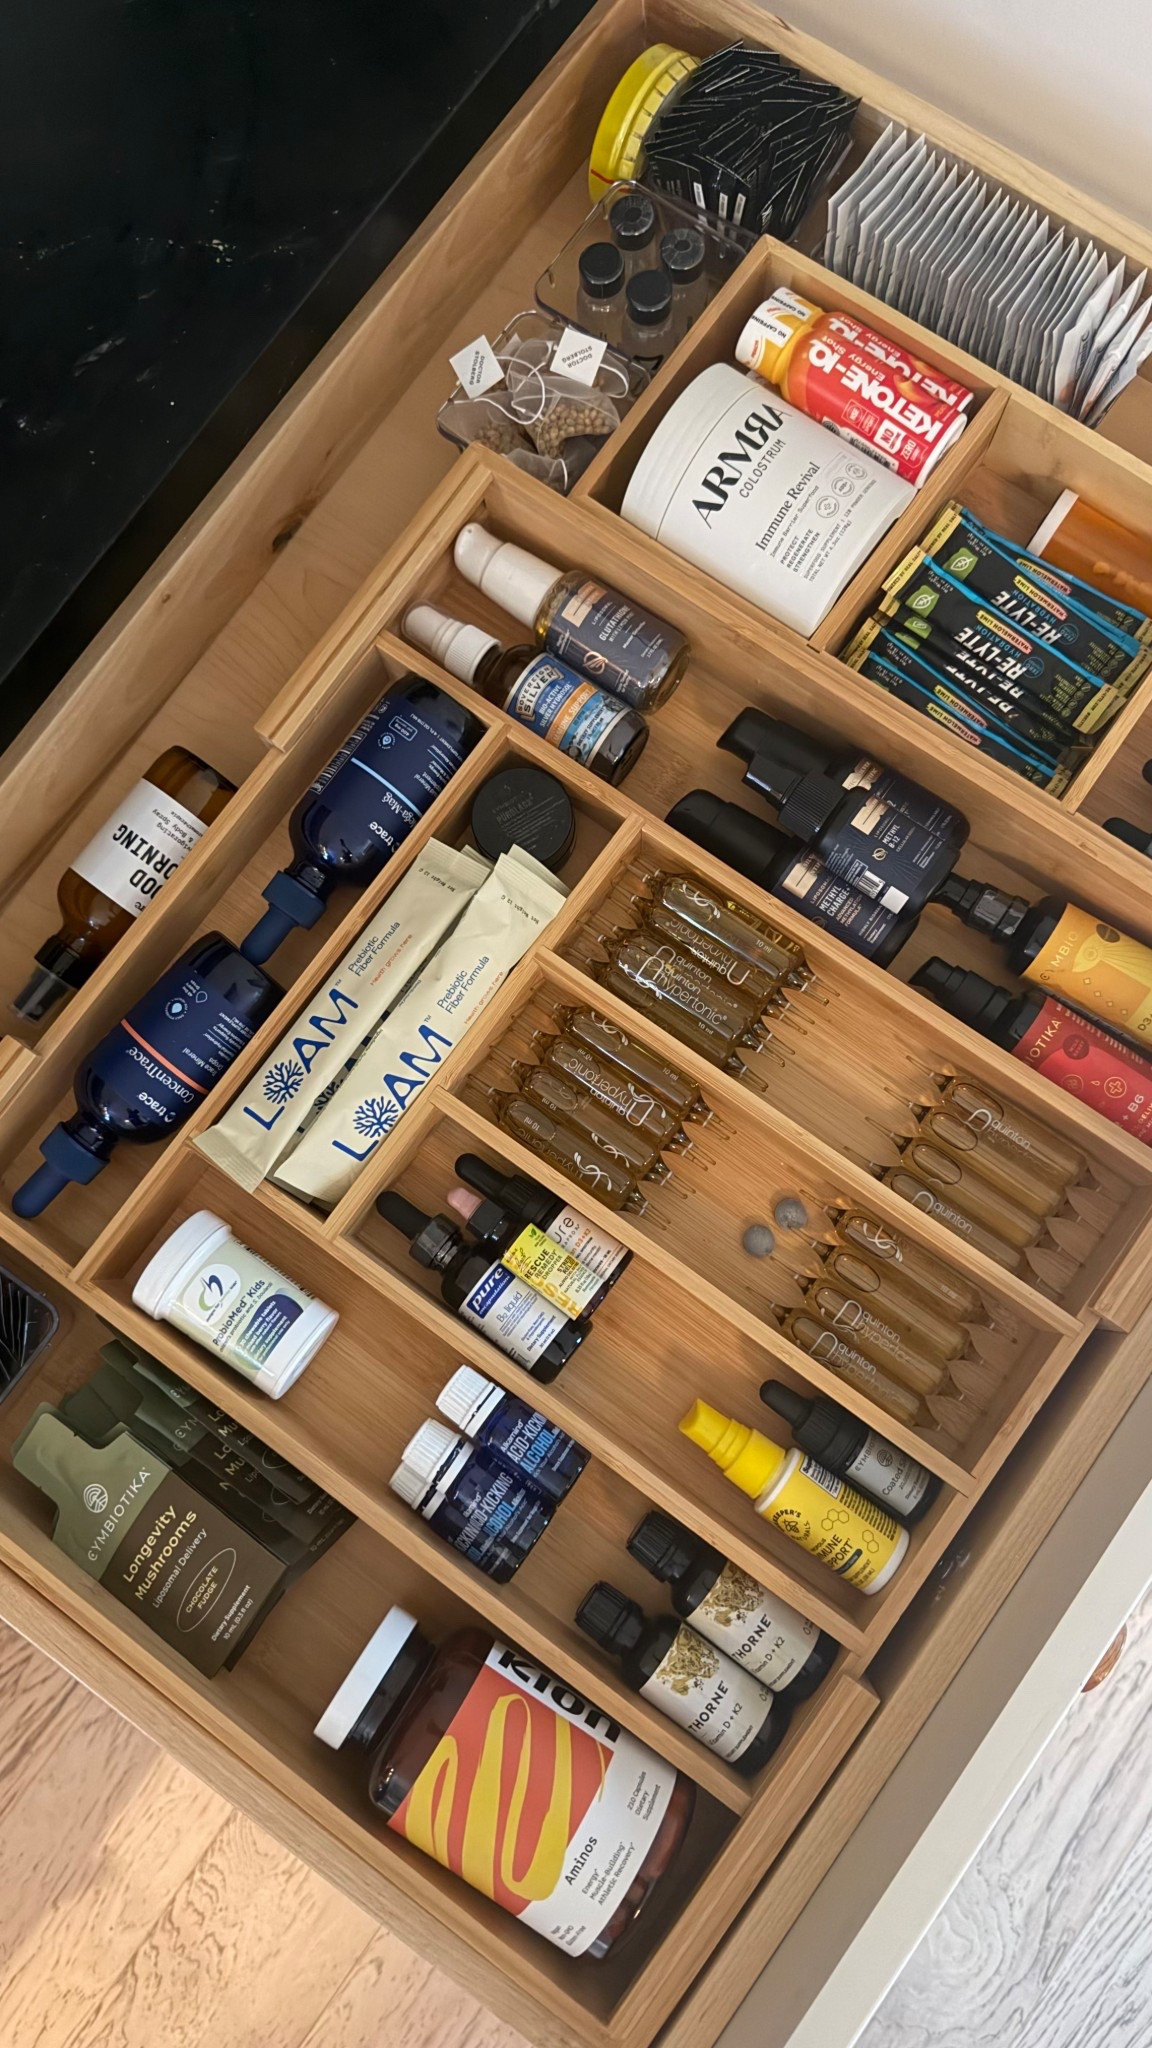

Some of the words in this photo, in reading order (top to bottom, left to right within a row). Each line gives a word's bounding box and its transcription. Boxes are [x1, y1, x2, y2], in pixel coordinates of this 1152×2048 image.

[820, 333, 847, 355] Shot
[467, 350, 481, 385] STOLBERG
[474, 355, 485, 383] DOCTOR
[847, 350, 887, 382] Energy
[799, 333, 944, 445] KETONE-IQ
[736, 435, 787, 500] COLOSTRUM
[753, 497, 796, 552] Immune
[785, 458, 821, 502] Revival
[778, 534, 801, 565] PROTECT
[783, 527, 815, 569] REGENERATE
[790, 530, 823, 573] STRENGTHEN
[1015, 578, 1030, 591] LIME
[990, 586, 1062, 649] RE-LYTE
[1028, 587, 1065, 618] WATERMELON
[978, 613, 993, 626] LIME
[992, 620, 1029, 652] WATERMELON
[953, 620, 1027, 686] RE-LYTE
[974, 620, 1021, 661] HYDRATION
[512, 662, 551, 712] SOVEREIGN
[519, 667, 557, 713] SILVER
[537, 683, 562, 715] BIO-ACTIVE
[150, 807, 171, 825] Spray
[170, 822, 188, 838] Body
[365, 819, 396, 847] trace
[881, 822, 900, 845] METHYL
[110, 822, 179, 880] ORNING
[818, 883, 841, 913] METHYL
[346, 932, 380, 974] Prebiotic
[353, 952, 375, 978] Fiber
[369, 918, 401, 957] Formula
[444, 989, 466, 1014] Fiber
[459, 953, 490, 991] Formula
[661, 964, 703, 996] quinton
[673, 953, 714, 984] quinton
[436, 968, 468, 1008] Prebiotic
[181, 1046, 206, 1068] Mineral
[135, 1088, 168, 1117] trace
[1126, 1091, 1145, 1113] B6
[988, 1117, 1032, 1150] quinton
[550, 1214, 575, 1245] ure
[930, 1200, 975, 1233] quinton
[523, 1246, 550, 1281] RESCUE
[533, 1247, 558, 1280] REMEDY
[245, 1276, 265, 1299] Kids
[469, 1264, 505, 1312] pure
[502, 1289, 523, 1314] liquid
[858, 1310, 904, 1343] quinton
[834, 1341, 879, 1374] quinton
[517, 1427, 556, 1474] ALCOHOL
[880, 1466, 905, 1497] Coated
[119, 1502, 180, 1584] Longevity
[131, 1507, 199, 1601] Mushrooms
[150, 1564, 183, 1608] Liposomal
[176, 1525, 209, 1568] Delivery
[183, 1564, 219, 1614] CHOCOLATE
[196, 1580, 218, 1610] FUDGE
[730, 1610, 774, 1665] THORNE
[763, 1651, 774, 1661] D
[772, 1635, 786, 1649] K2
[687, 1678, 731, 1735] THORNE
[721, 1719, 732, 1729] D
[730, 1701, 743, 1715] K2
[628, 1769, 651, 1798] Capsules
[630, 1789, 653, 1816] Dietary
[635, 1782, 667, 1821] Supplement
[561, 1834, 600, 1886] Aminos
[594, 1875, 618, 1906] Athletic
